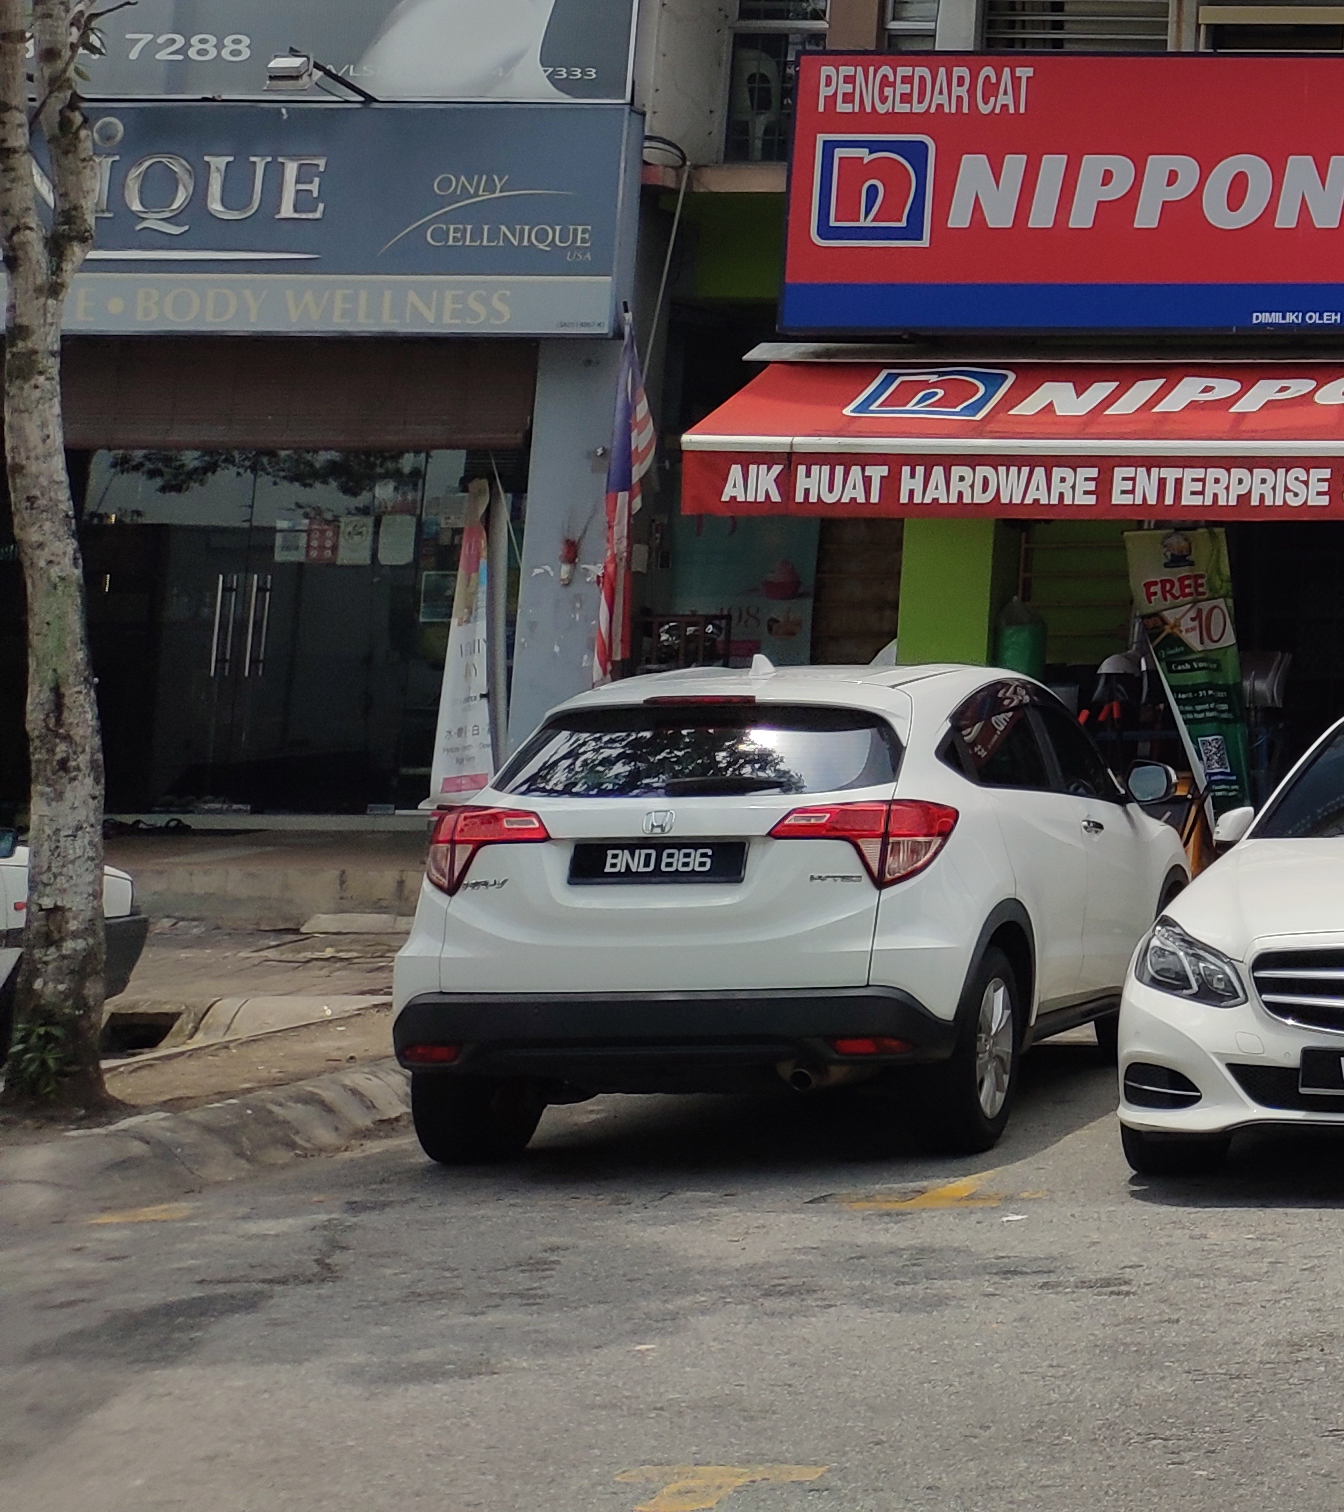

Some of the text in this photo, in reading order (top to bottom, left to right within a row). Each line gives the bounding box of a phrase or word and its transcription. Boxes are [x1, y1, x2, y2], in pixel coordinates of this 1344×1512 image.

[125, 34, 251, 62] 7288
[817, 66, 1034, 115] PENGEDAR CAT
[433, 173, 510, 197] ONLY
[426, 223, 593, 251] CELLNIQUE
[566, 250, 592, 262] USA
[135, 289, 268, 323] BODY
[285, 289, 512, 324] WELLNESS
[1252, 310, 1302, 324] DIMILIKI
[1304, 311, 1342, 325] OLEH
[721, 464, 783, 503] AIK
[794, 465, 889, 504] HUAT
[900, 465, 1099, 506] HARDWARE
[1110, 467, 1331, 507] ENTERPRISE
[1143, 573, 1207, 604] FREE
[1190, 605, 1227, 645] 10
[604, 849, 713, 873] BND 886
